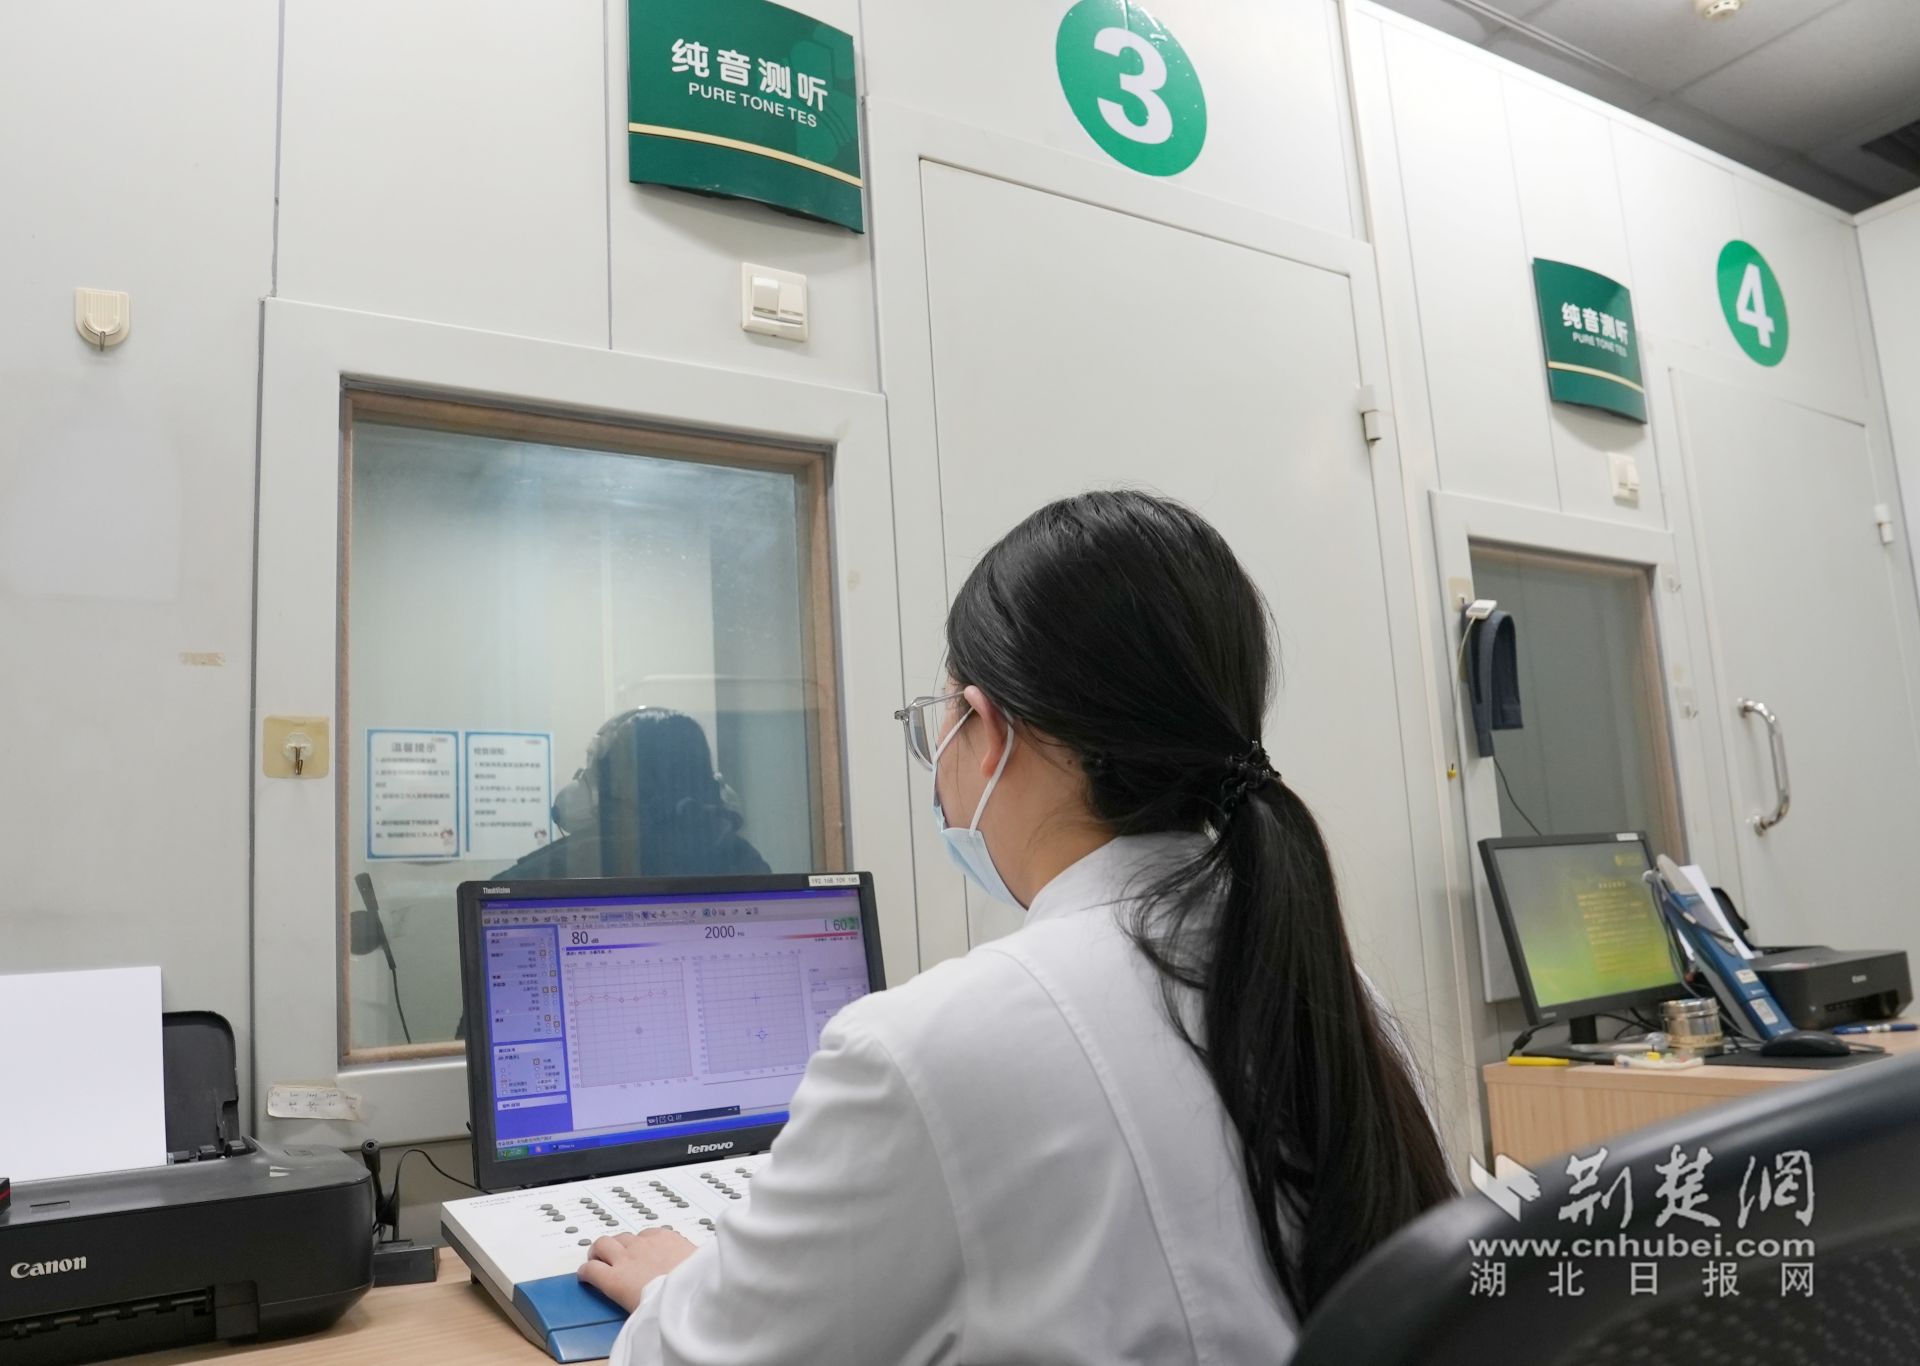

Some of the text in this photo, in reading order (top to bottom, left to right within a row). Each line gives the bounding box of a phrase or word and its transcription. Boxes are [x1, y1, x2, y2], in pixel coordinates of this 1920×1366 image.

[671, 38, 828, 112] 纯音测听
[1093, 26, 1173, 145] 3
[688, 82, 817, 128] PURE TONE TES
[1561, 302, 1629, 346] 纯音测听
[1735, 262, 1776, 348] 4
[1572, 331, 1595, 347] PURE
[571, 931, 589, 945] 80
[705, 925, 736, 939] 2000
[687, 1141, 734, 1155] lenovo
[10, 1255, 87, 1279] Canon
